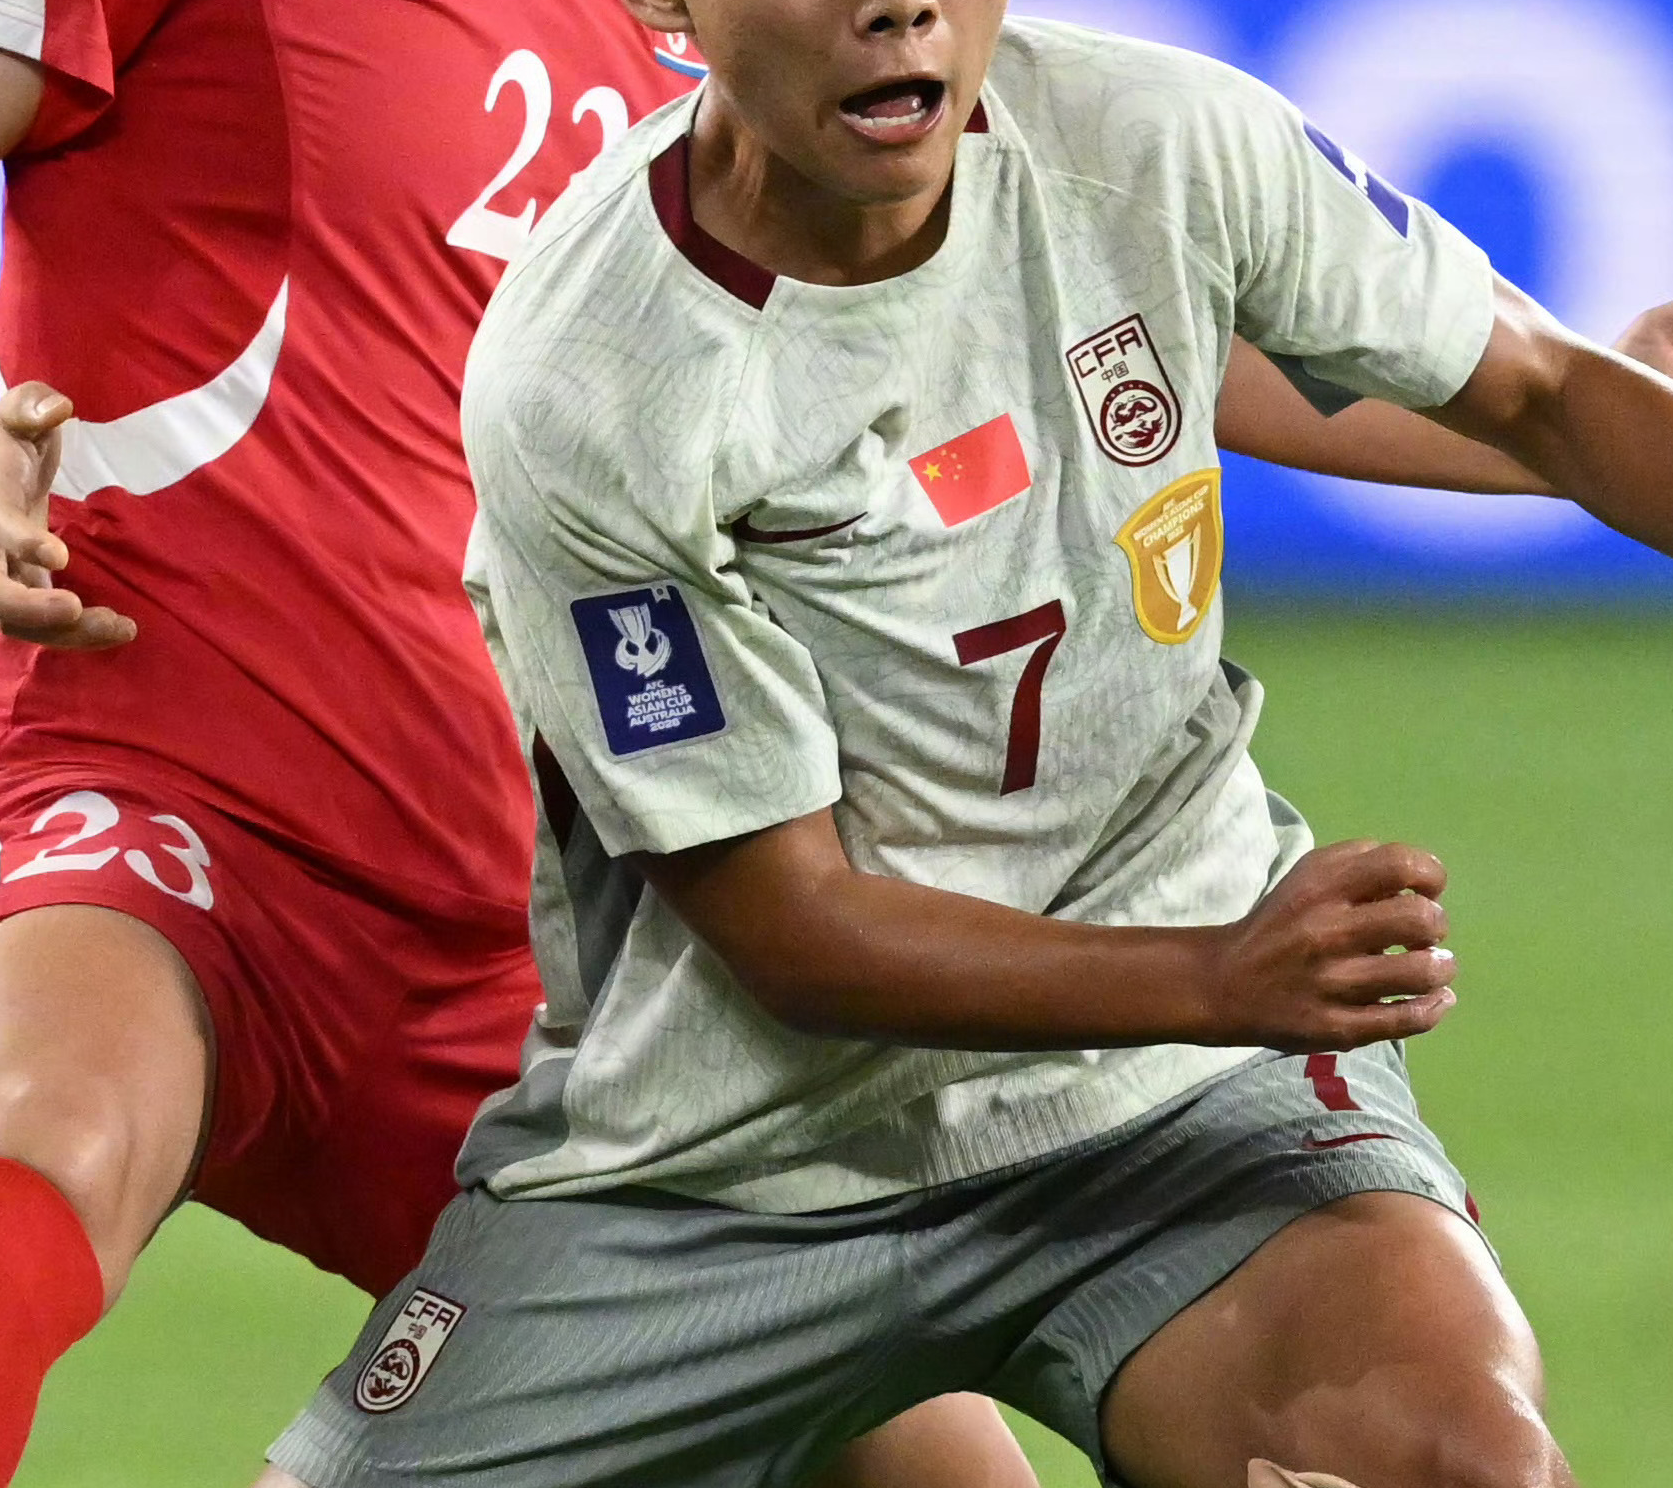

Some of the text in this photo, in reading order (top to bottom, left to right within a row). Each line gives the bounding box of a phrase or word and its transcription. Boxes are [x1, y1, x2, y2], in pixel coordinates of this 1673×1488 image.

[1074, 326, 1143, 379] CFA
[1101, 360, 1130, 383] 中国
[1142, 499, 1204, 548] CHAMPIONS
[627, 684, 687, 706] WOMEN'S
[645, 679, 665, 691] AFC
[627, 694, 693, 718] ASIAN CUP
[954, 599, 1065, 797] 7
[630, 705, 696, 728] AUSTRALIA
[649, 718, 681, 732] 2026
[2, 791, 216, 912] 23
[403, 1295, 457, 1332] CFA
